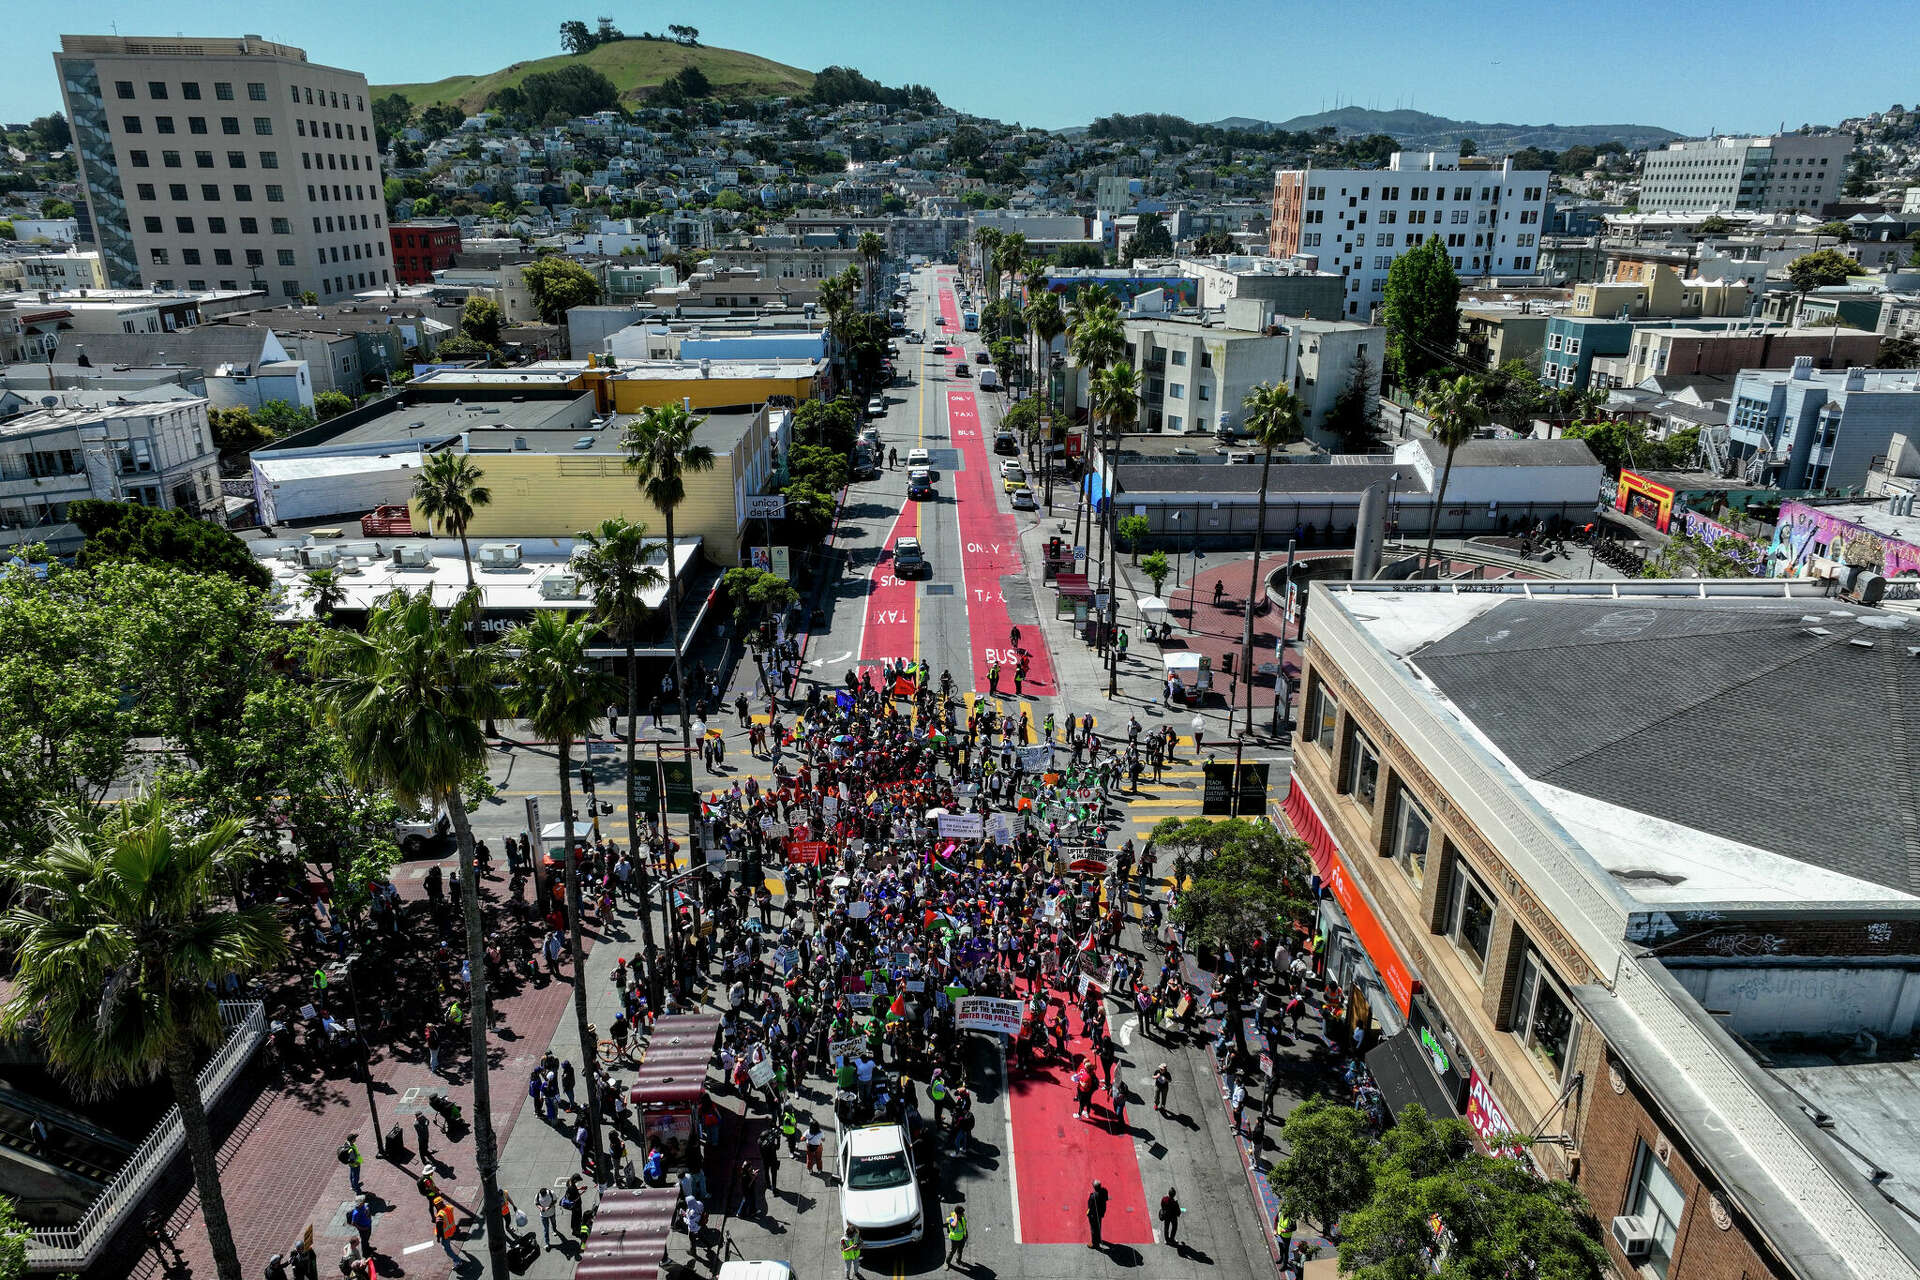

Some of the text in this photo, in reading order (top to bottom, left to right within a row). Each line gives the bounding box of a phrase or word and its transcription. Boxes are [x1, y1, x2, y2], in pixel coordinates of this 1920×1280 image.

[967, 543, 1000, 554] ONY
[985, 648, 1018, 665] BUS
[996, 1002, 1018, 1011] WORKERS
[994, 1014, 1020, 1025] PALESTINE
